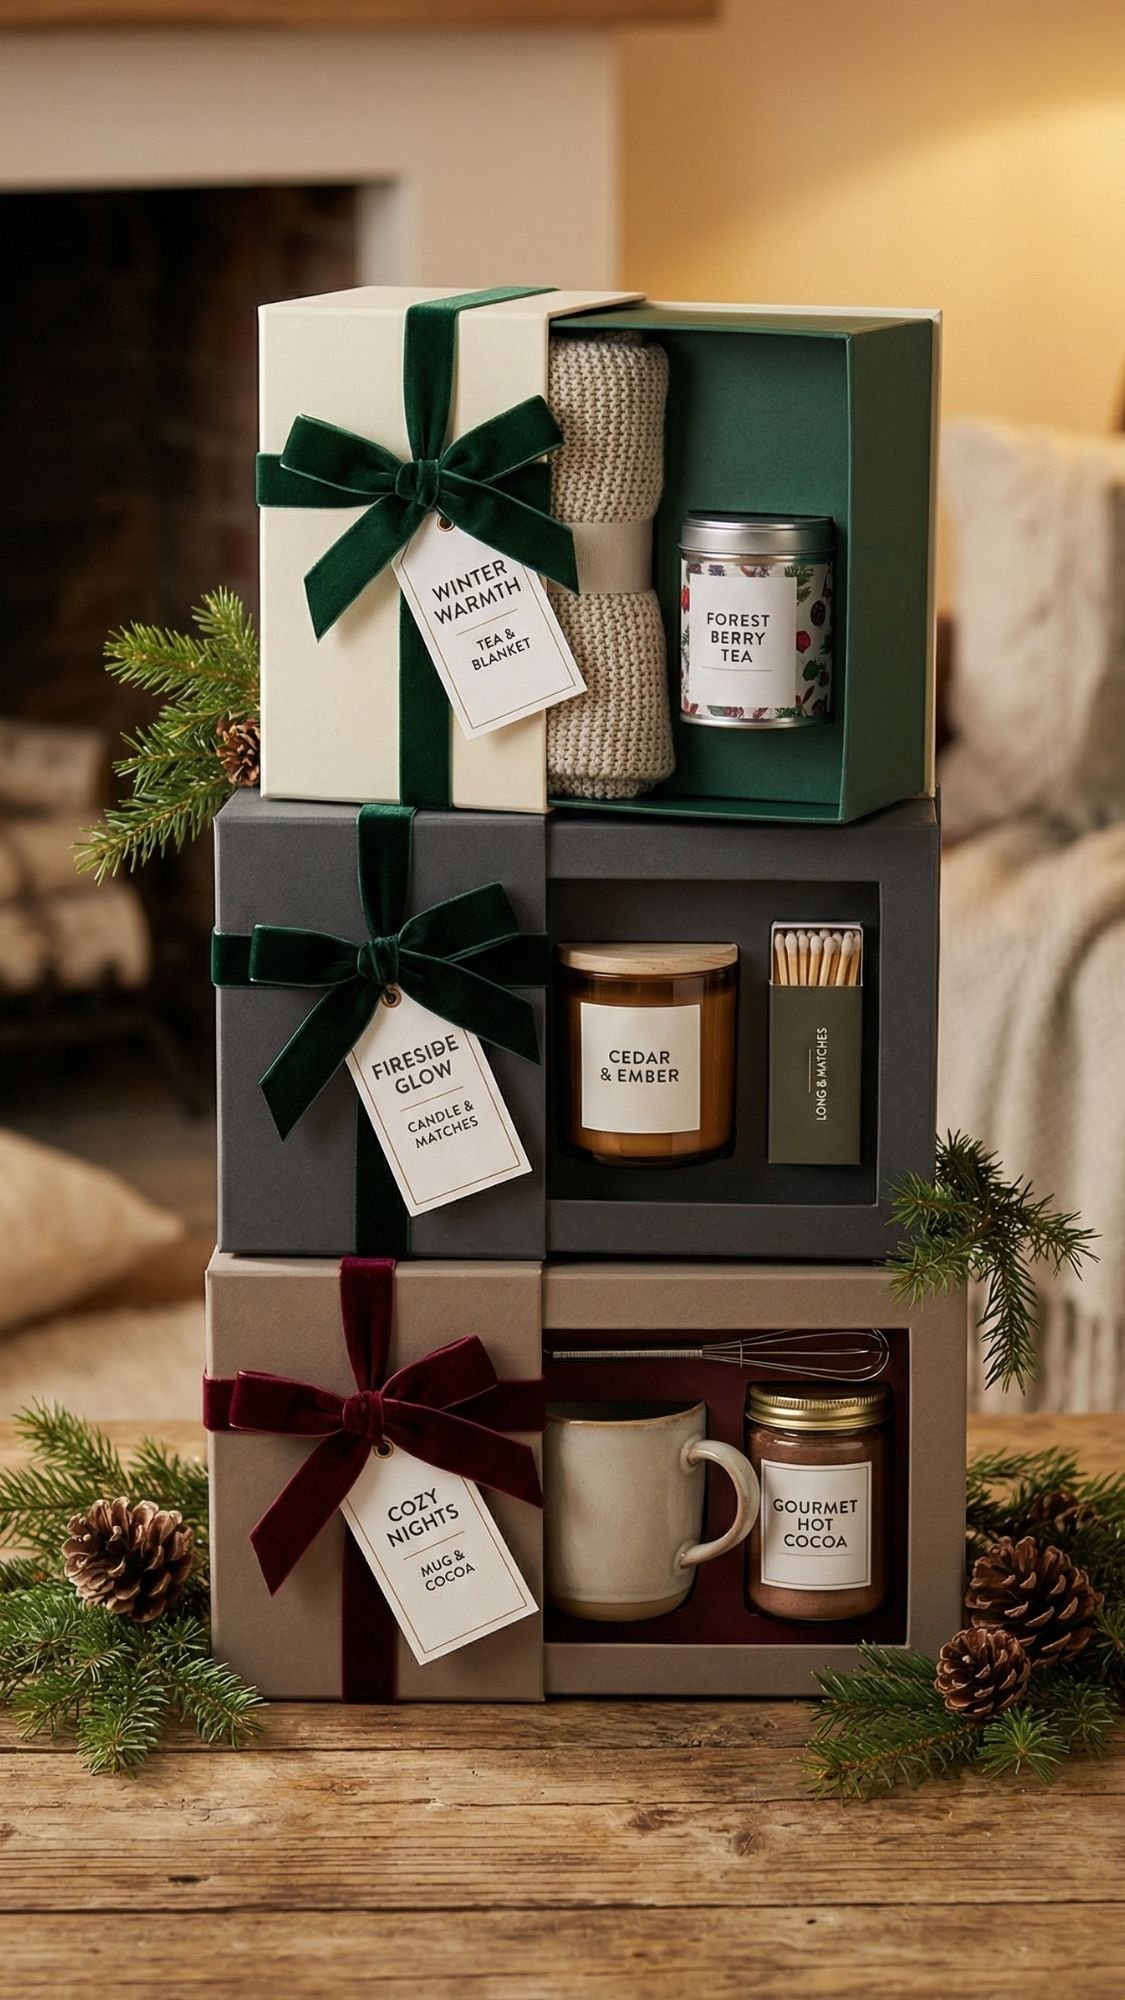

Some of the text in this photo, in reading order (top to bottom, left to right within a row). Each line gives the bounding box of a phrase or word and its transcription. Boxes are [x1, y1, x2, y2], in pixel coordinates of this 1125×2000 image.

[431, 559, 508, 602] WINTER
[433, 576, 522, 625] WARMTH
[706, 612, 771, 627] FOREST
[476, 628, 516, 651] TEA &
[711, 630, 766, 646] BERRY
[471, 637, 531, 671] BLANKET
[720, 648, 753, 663] TEA
[608, 1050, 670, 1065] CEDAR
[816, 1027, 828, 1078] MATCHES
[394, 1059, 452, 1094] GLOW
[600, 1067, 680, 1083] & EMBER
[407, 1100, 475, 1133] CANDLE &
[815, 1089, 827, 1121] LONG
[415, 1115, 479, 1149] MATCHES
[387, 1487, 437, 1522] COZY
[773, 1498, 858, 1514] GOURMET
[386, 1503, 459, 1548] NIGHTS
[797, 1518, 834, 1531] HOT
[783, 1533, 848, 1548] COCOA
[420, 1549, 466, 1578] MUG &
[425, 1563, 476, 1591] COCOA
